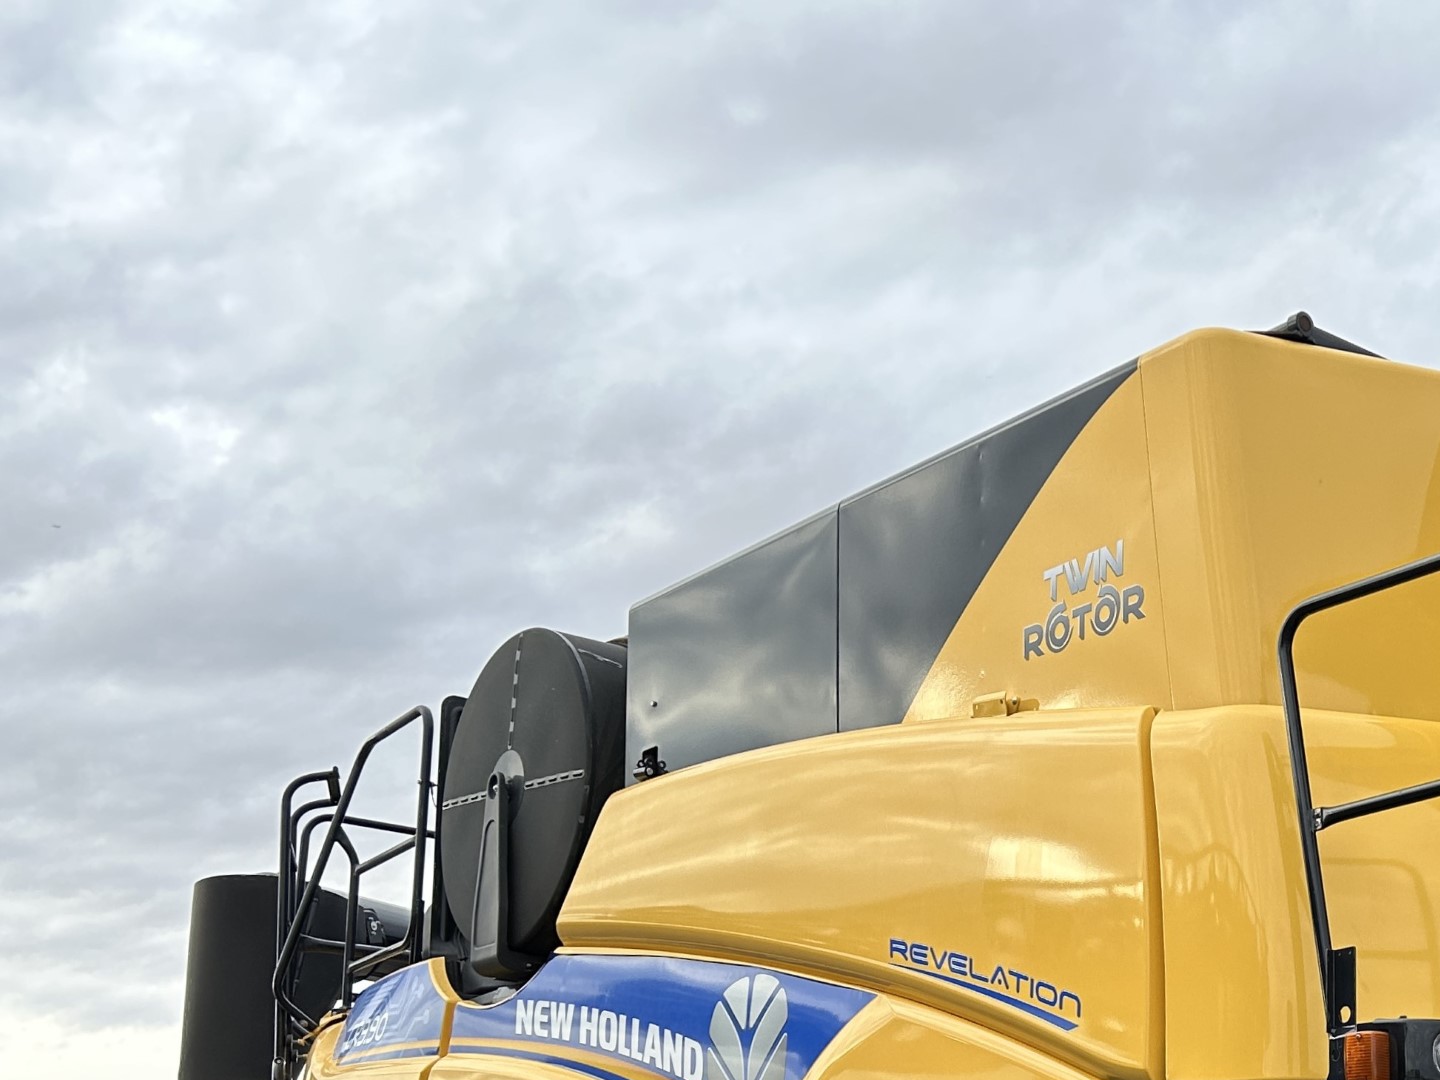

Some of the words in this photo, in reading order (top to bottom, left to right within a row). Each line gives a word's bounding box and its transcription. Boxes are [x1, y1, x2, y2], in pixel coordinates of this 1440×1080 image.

[1043, 538, 1125, 602] TWIN
[1022, 583, 1147, 661] ROTOR
[888, 937, 1082, 1018] REVELATION
[515, 999, 575, 1042] NEW
